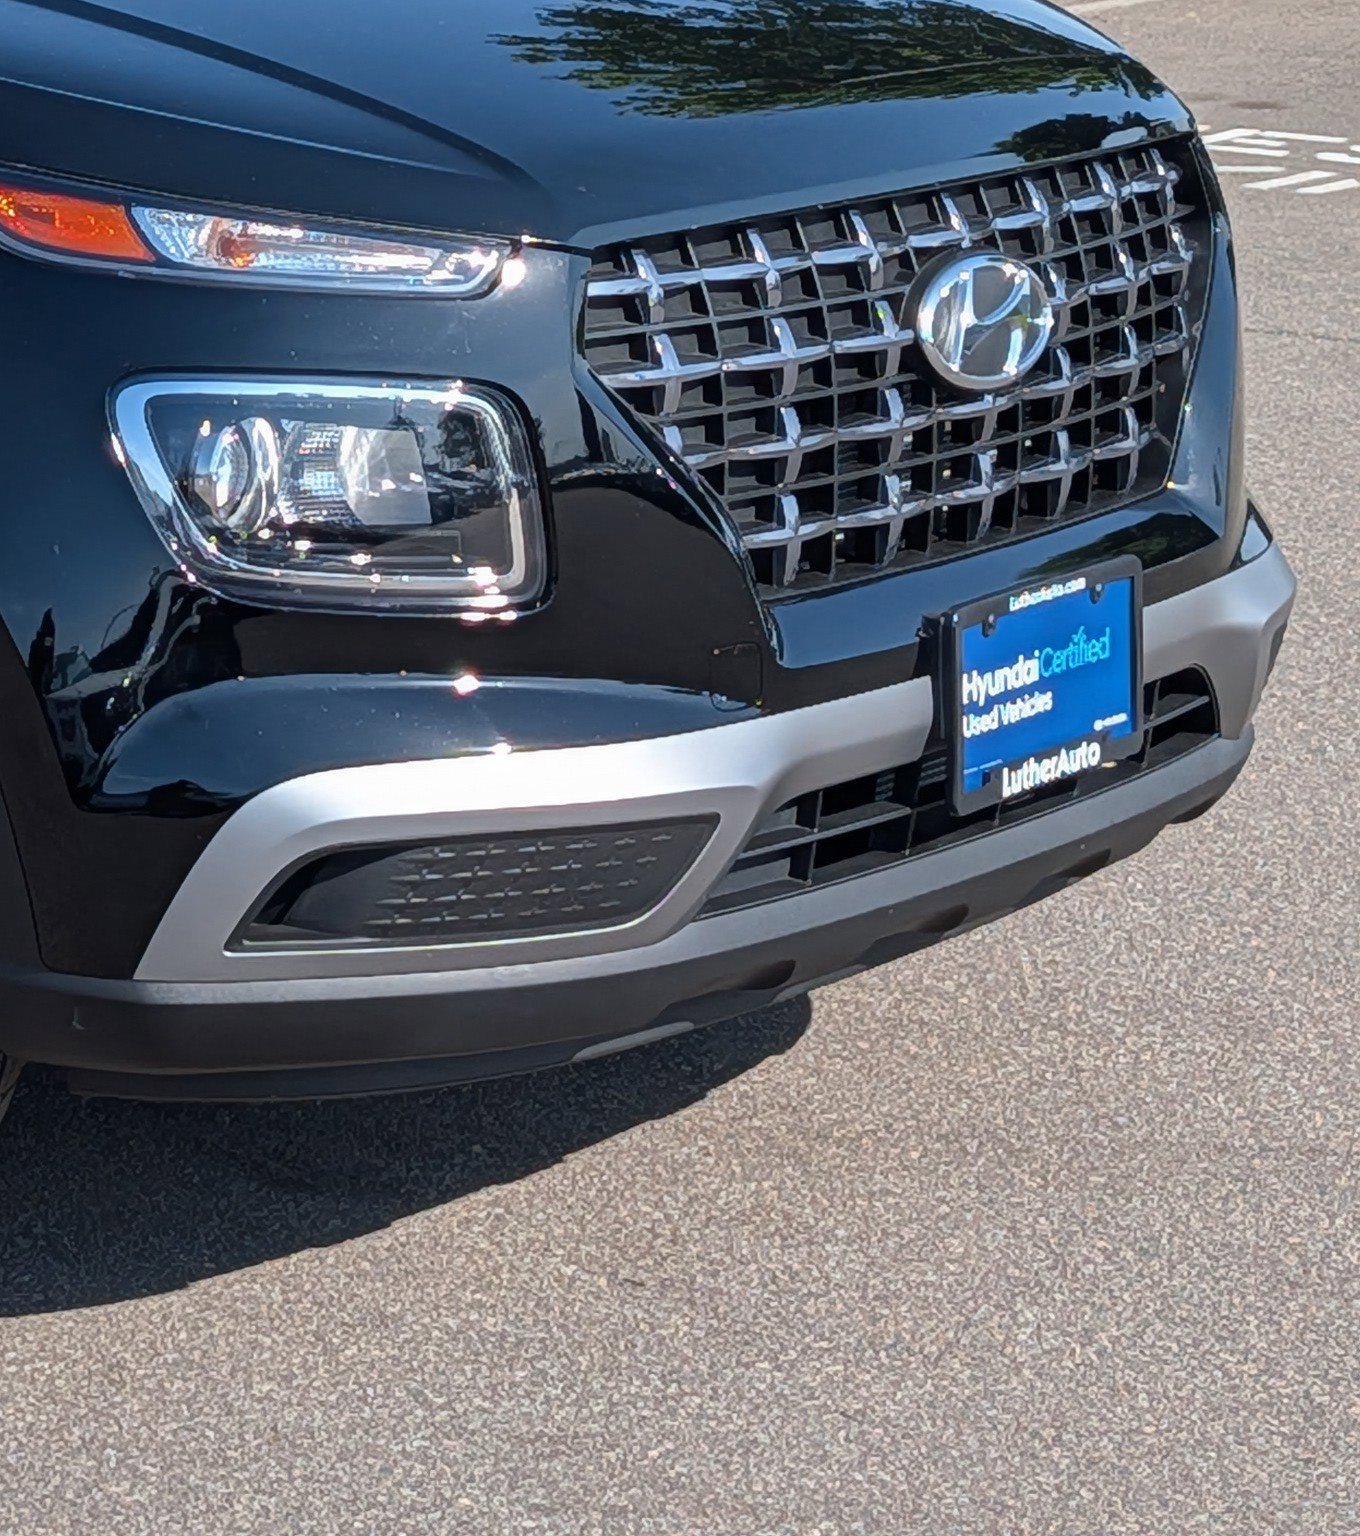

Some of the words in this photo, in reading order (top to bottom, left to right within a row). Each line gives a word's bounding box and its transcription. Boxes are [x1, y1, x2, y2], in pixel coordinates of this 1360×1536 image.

[962, 706, 1000, 739] Used
[1000, 689, 1054, 726] Vehicles
[1001, 740, 1102, 798] LutherAuto
